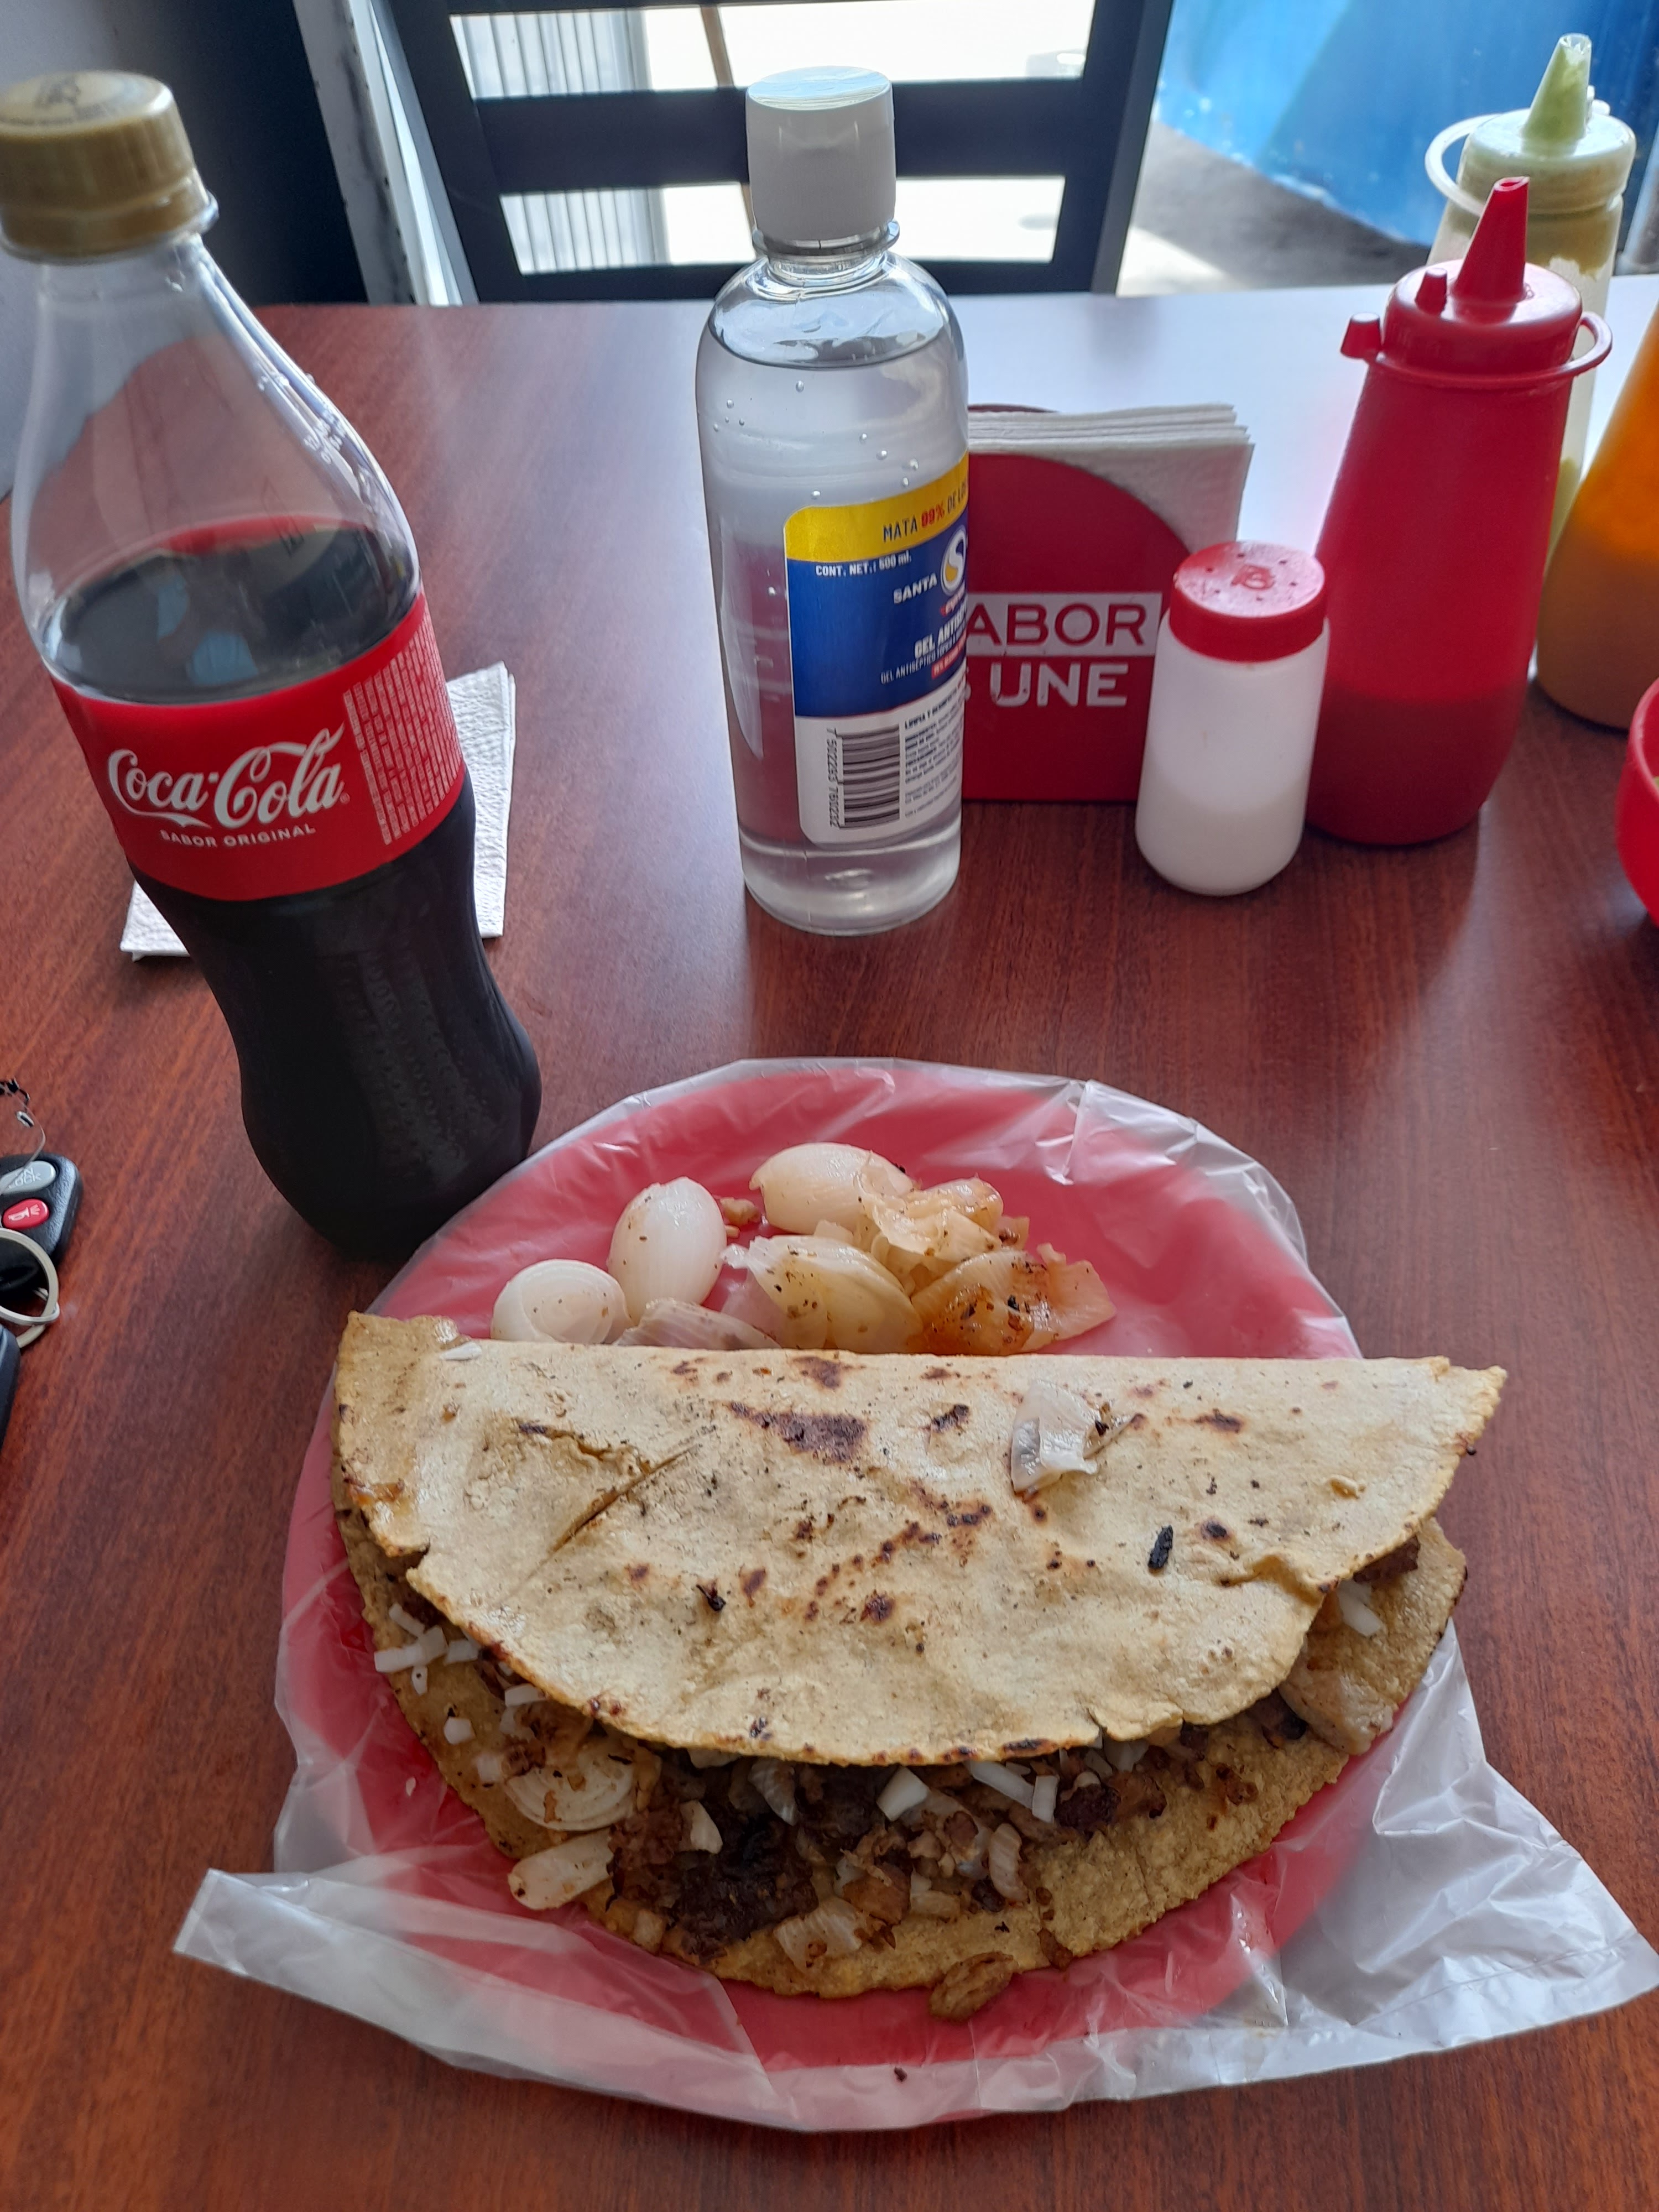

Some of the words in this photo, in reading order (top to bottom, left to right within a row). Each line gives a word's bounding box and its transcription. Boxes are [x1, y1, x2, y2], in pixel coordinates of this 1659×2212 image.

[883, 515, 918, 542] MATA
[815, 564, 847, 577] CONT.
[893, 572, 937, 604] SANTA
[914, 633, 936, 659] GEL
[989, 662, 1129, 707] UNE
[108, 721, 345, 829] Coca-Cola
[160, 830, 218, 848] SABOR
[223, 823, 316, 847] ORIGINAL
